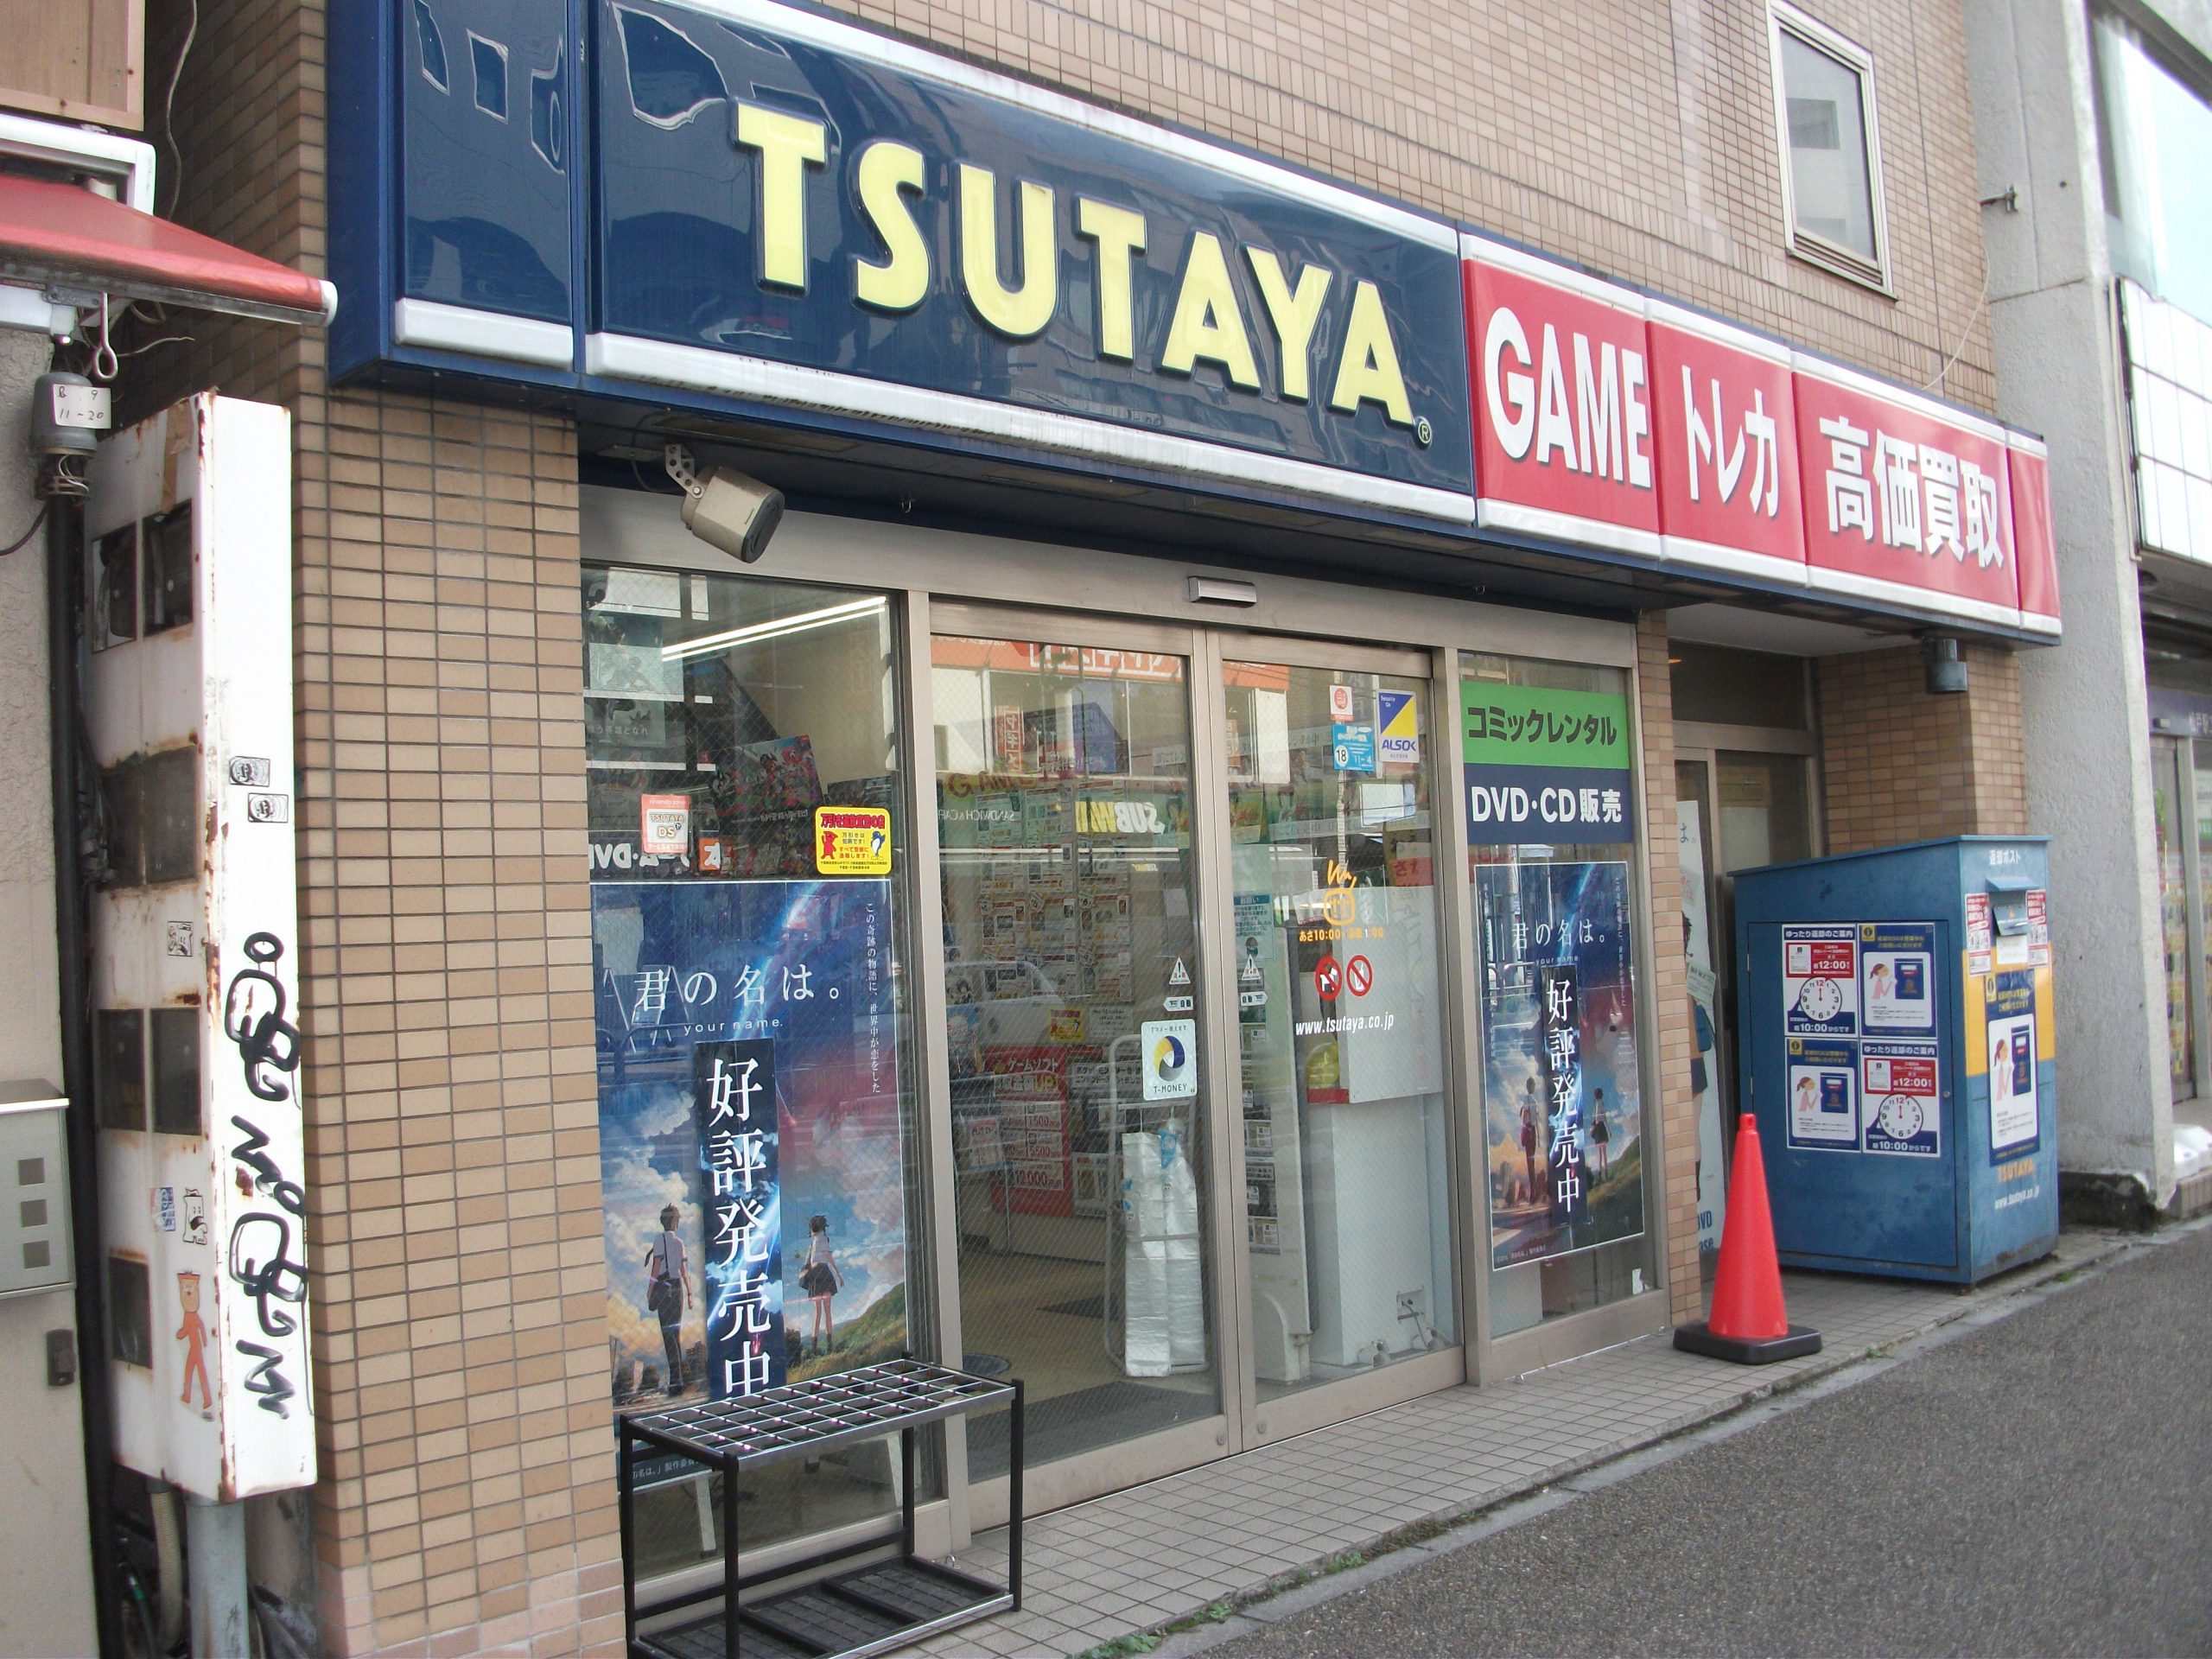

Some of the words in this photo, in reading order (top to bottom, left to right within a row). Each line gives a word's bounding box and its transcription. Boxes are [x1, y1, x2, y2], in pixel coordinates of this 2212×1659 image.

[737, 99, 1416, 427] TSUTAYA
[1484, 306, 1652, 490] GAME
[1681, 364, 1779, 518] トレカ
[1818, 415, 2005, 568] 高価買取
[1382, 739, 1417, 752] ALSOK
[1467, 705, 1618, 746] コミックレンタル
[1336, 749, 1347, 762] 18
[651, 814, 685, 823] TSUTAYA
[658, 826, 676, 838] DS
[633, 963, 840, 1013] 君の名は。
[683, 1020, 726, 1037] your
[1295, 1012, 1395, 1036] www.tsutaya.co.jp
[1154, 1084, 1187, 1094] T-MONEY
[1546, 978, 1581, 1213] 好評発売中
[706, 1057, 772, 1396] 好評発売中
